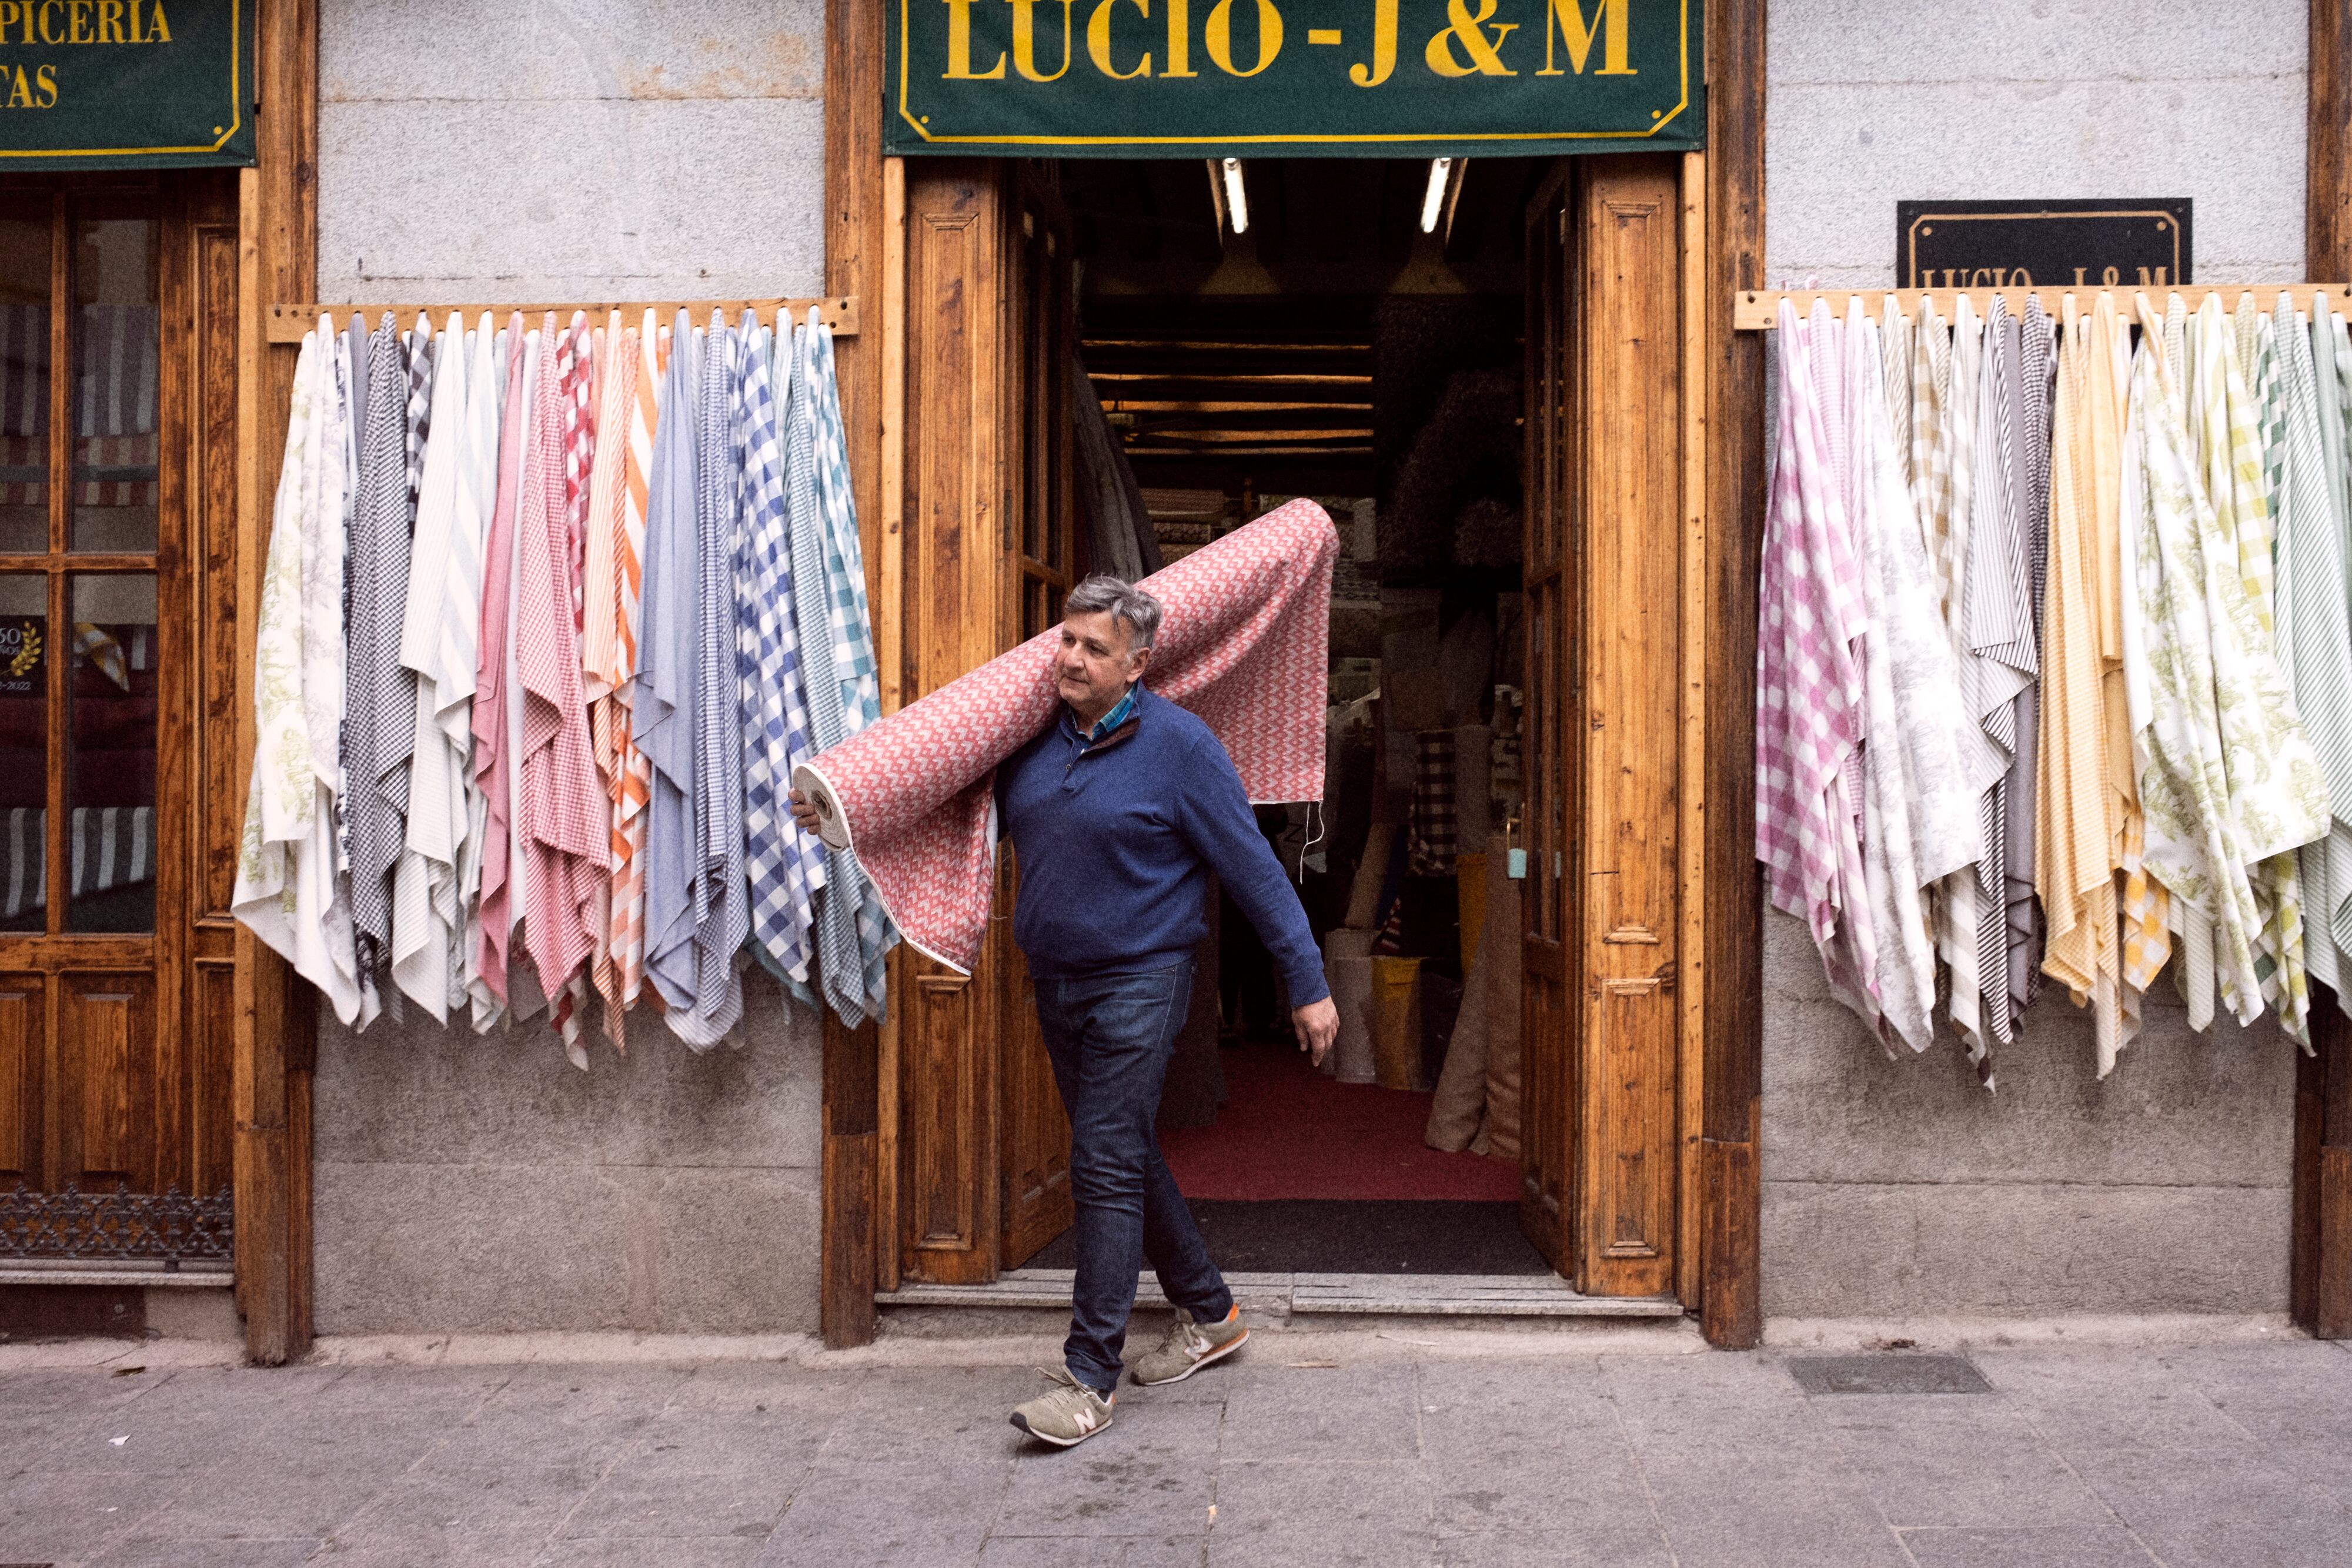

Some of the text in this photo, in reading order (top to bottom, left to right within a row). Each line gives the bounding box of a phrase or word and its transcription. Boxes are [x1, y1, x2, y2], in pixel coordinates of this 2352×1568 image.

[942, 0, 1284, 82] LUCIO
[1425, 0, 1519, 78] &
[1535, 0, 1638, 76] M
[1073, 1407, 1096, 1435] N
